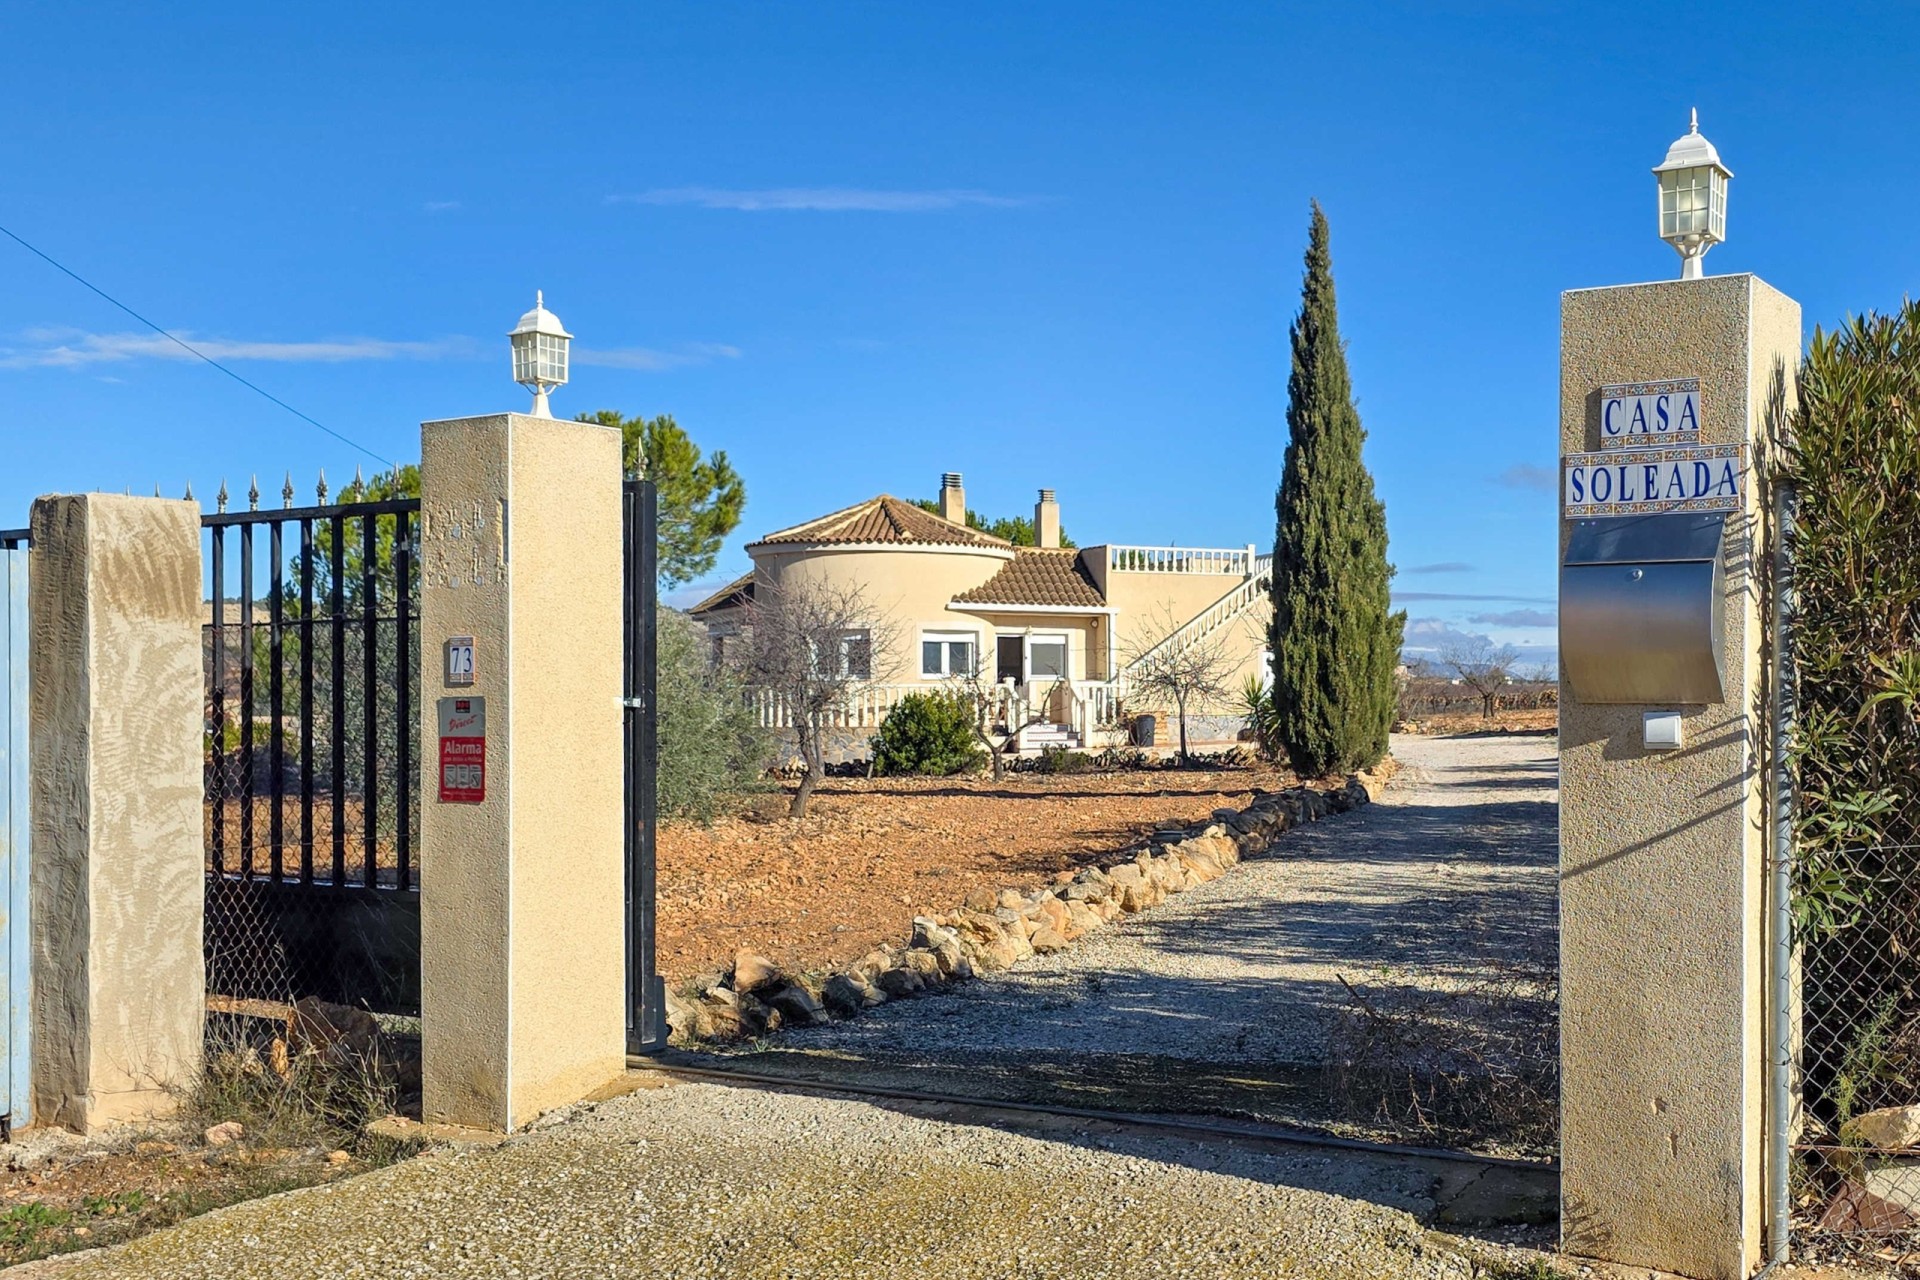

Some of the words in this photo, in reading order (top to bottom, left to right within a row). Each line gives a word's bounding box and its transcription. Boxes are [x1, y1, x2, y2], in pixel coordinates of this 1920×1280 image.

[1605, 394, 1698, 434] CASA
[1571, 460, 1737, 502] SOLEADA
[451, 647, 472, 673] 73
[444, 740, 482, 754] Alarma
